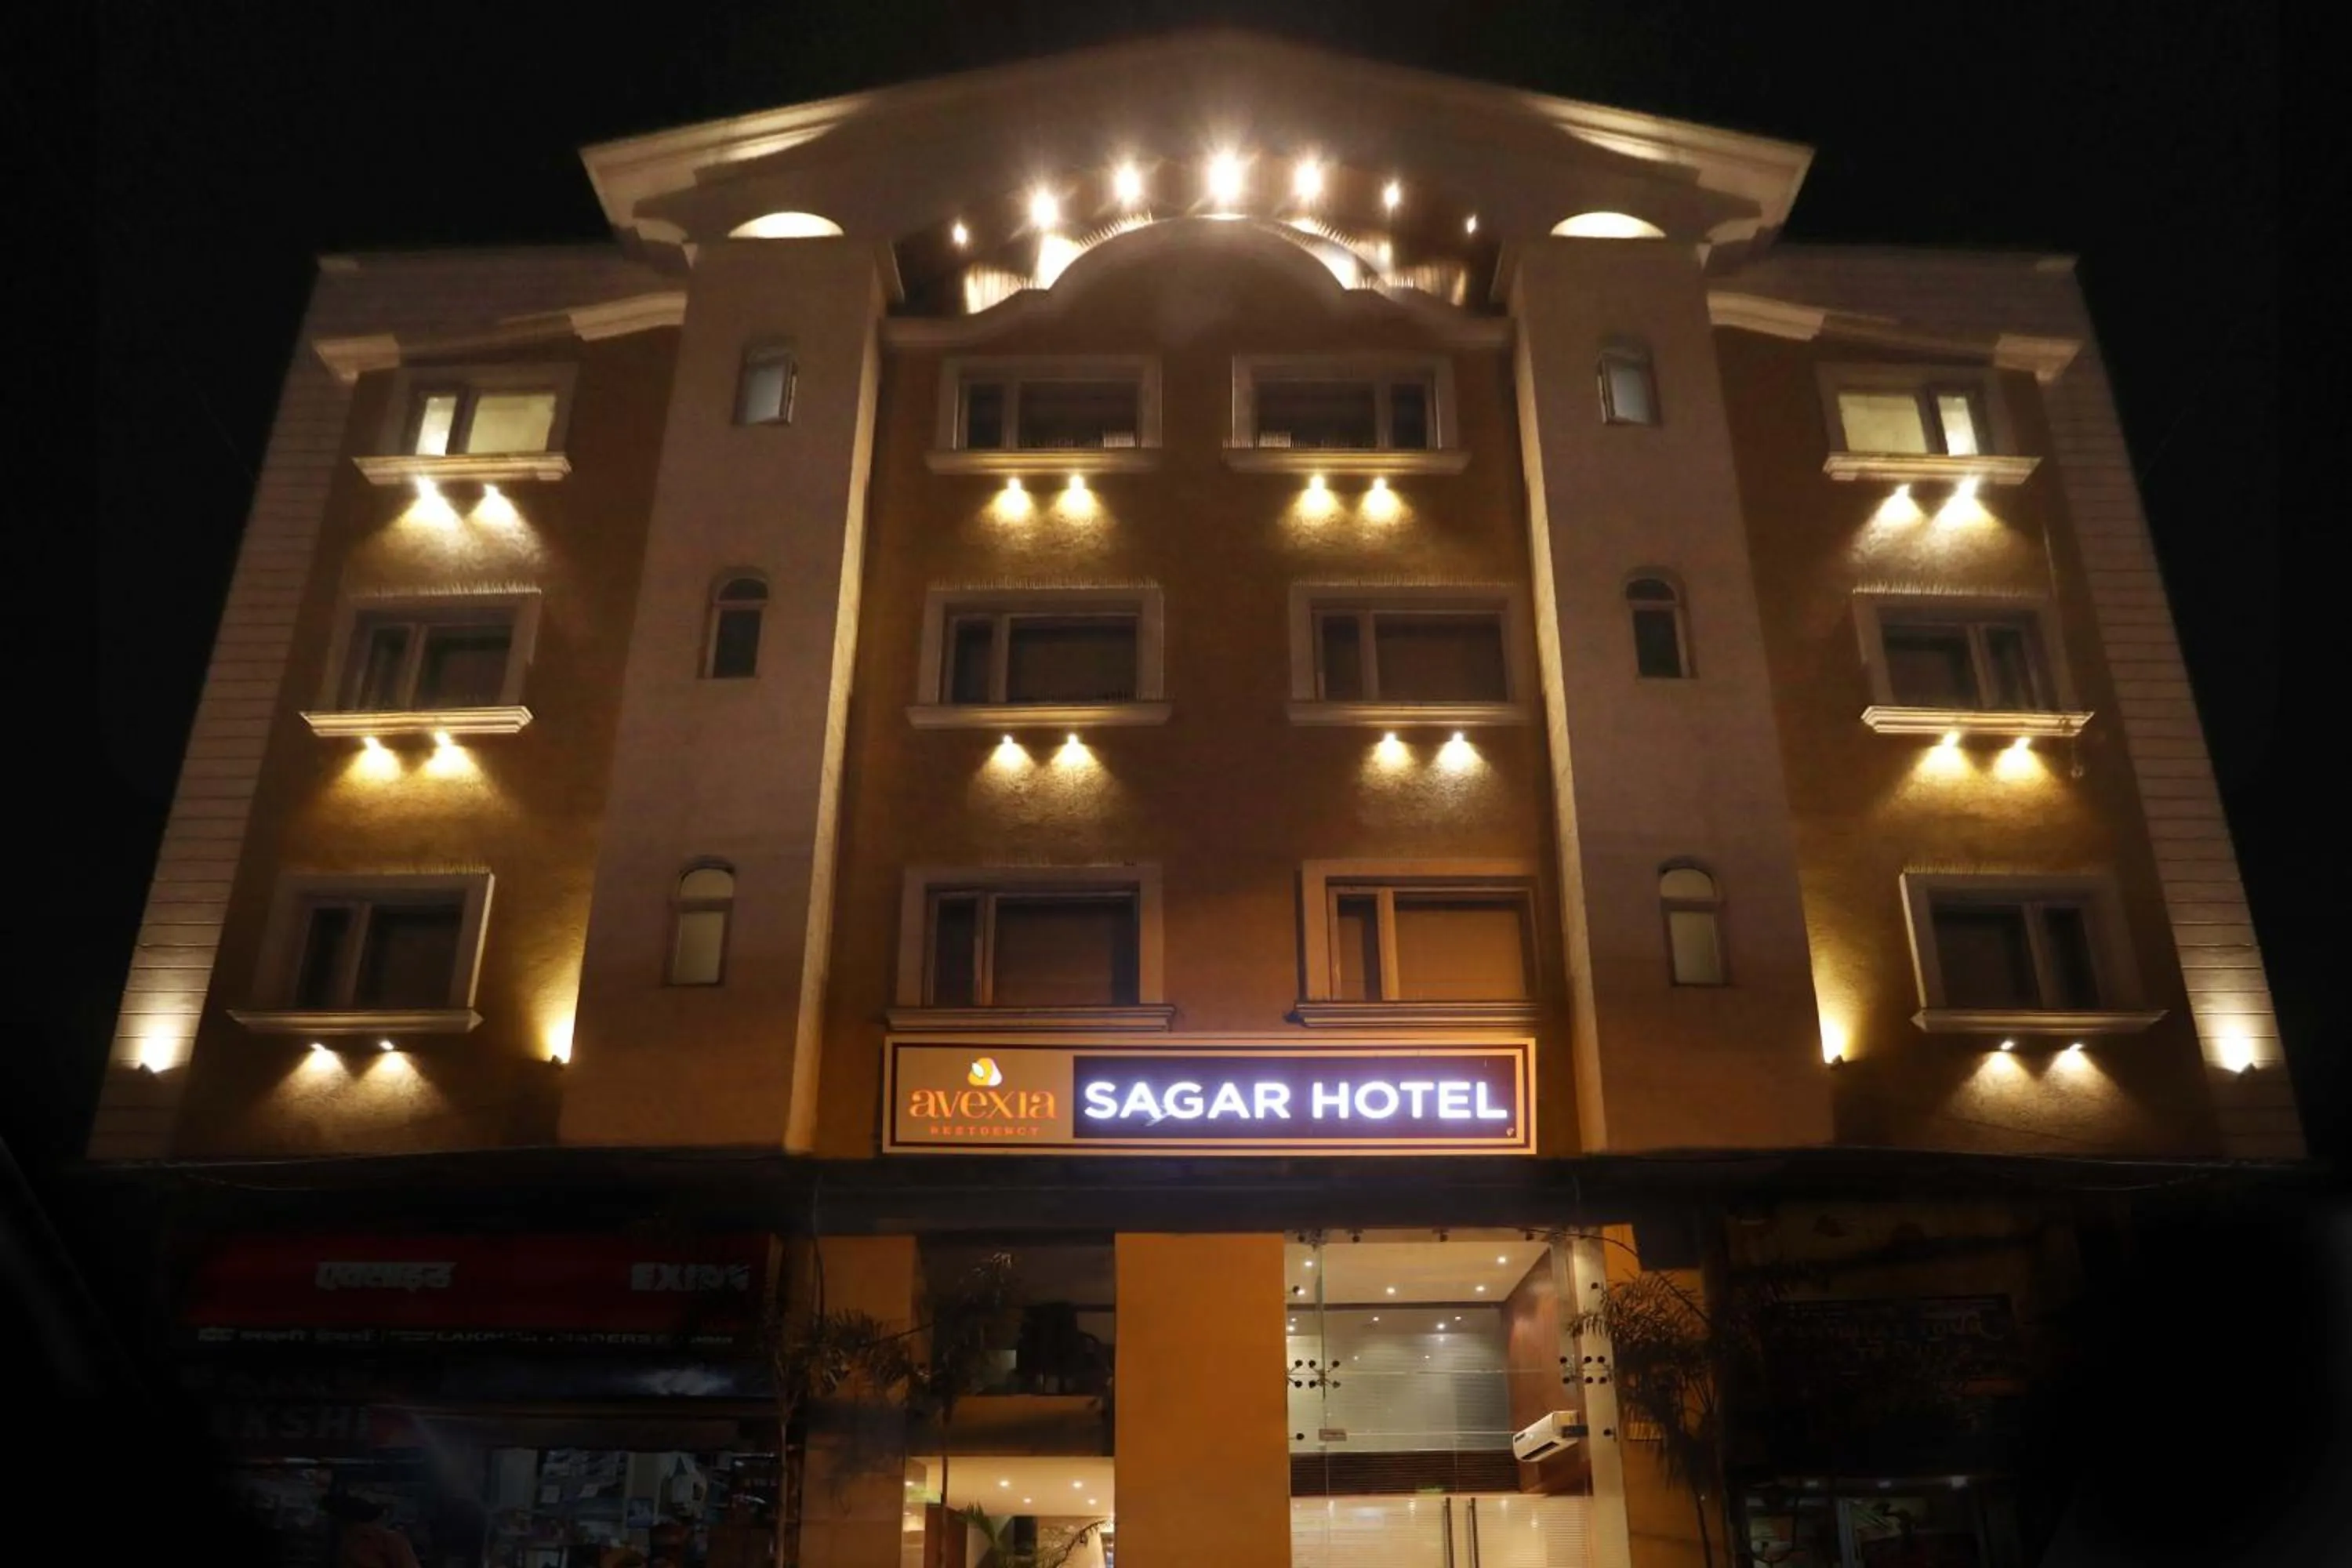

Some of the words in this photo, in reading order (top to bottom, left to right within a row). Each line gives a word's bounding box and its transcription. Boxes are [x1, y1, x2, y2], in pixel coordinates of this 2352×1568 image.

[909, 1088, 1057, 1120] avexia
[1083, 1080, 1291, 1120] SAGAR
[1312, 1080, 1509, 1120] HOTEL
[930, 1126, 1041, 1136] RESIDENCY
